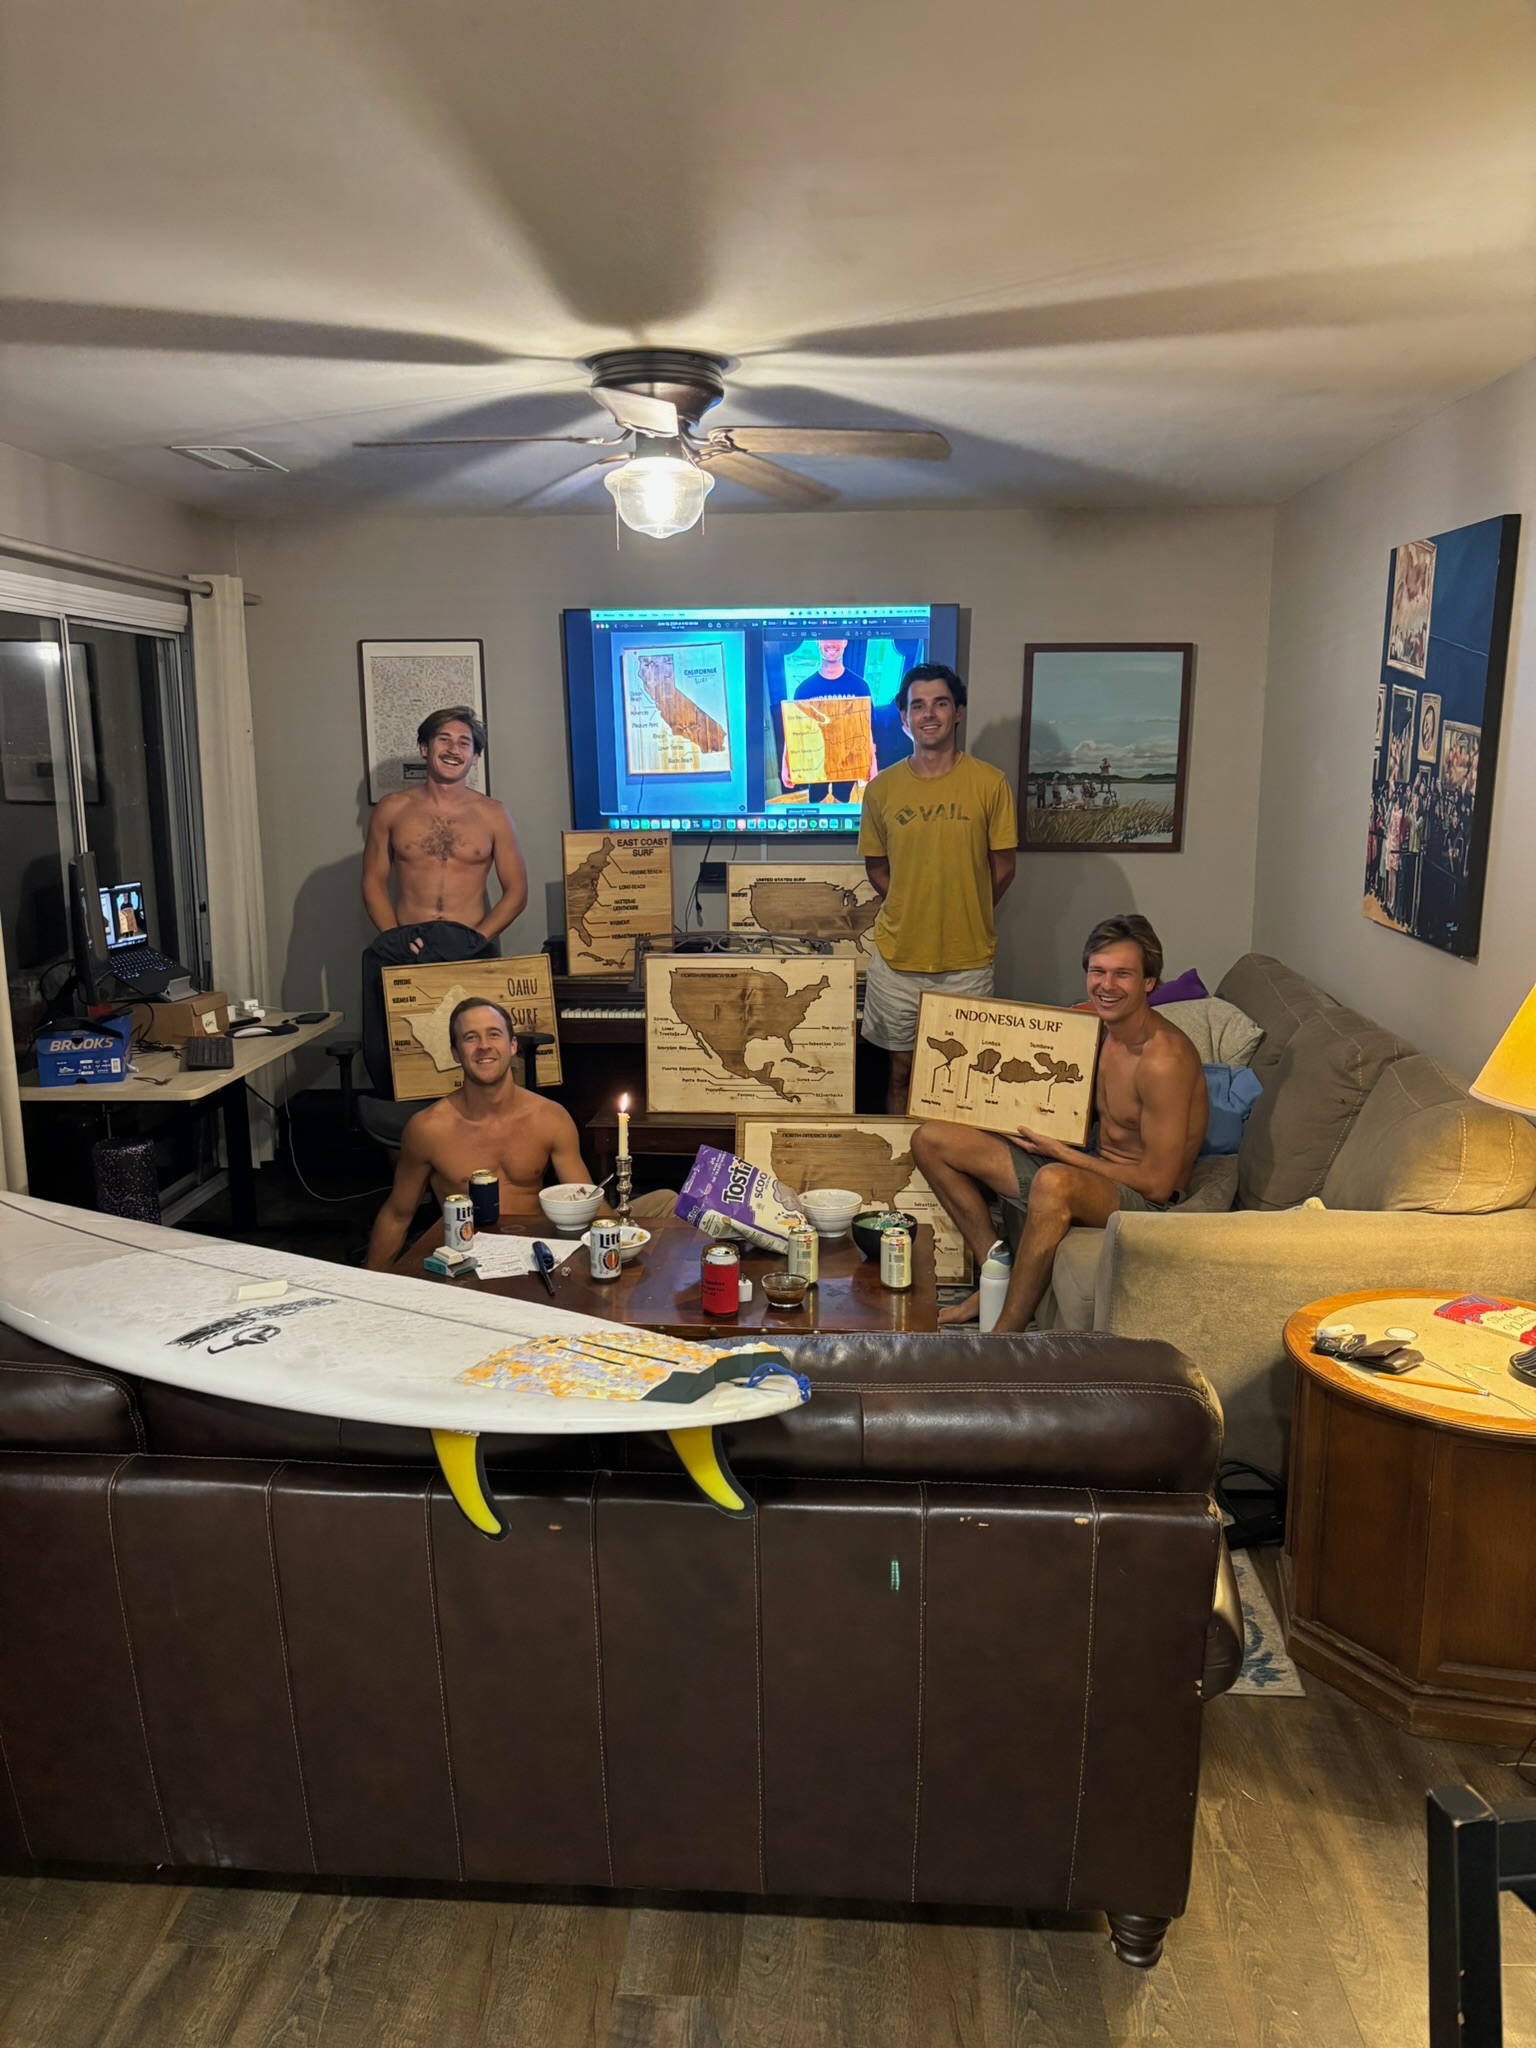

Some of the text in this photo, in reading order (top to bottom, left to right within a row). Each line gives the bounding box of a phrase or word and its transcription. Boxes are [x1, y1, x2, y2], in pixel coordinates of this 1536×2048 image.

[684, 668, 717, 676] CALIFORNIA
[920, 802, 968, 822] VAIL
[617, 838, 668, 847] EAST COAST
[632, 849, 654, 857] SURF
[511, 1007, 538, 1026] SURF
[955, 1008, 1063, 1032] INDONESIA SURF
[456, 1206, 474, 1222] Lit
